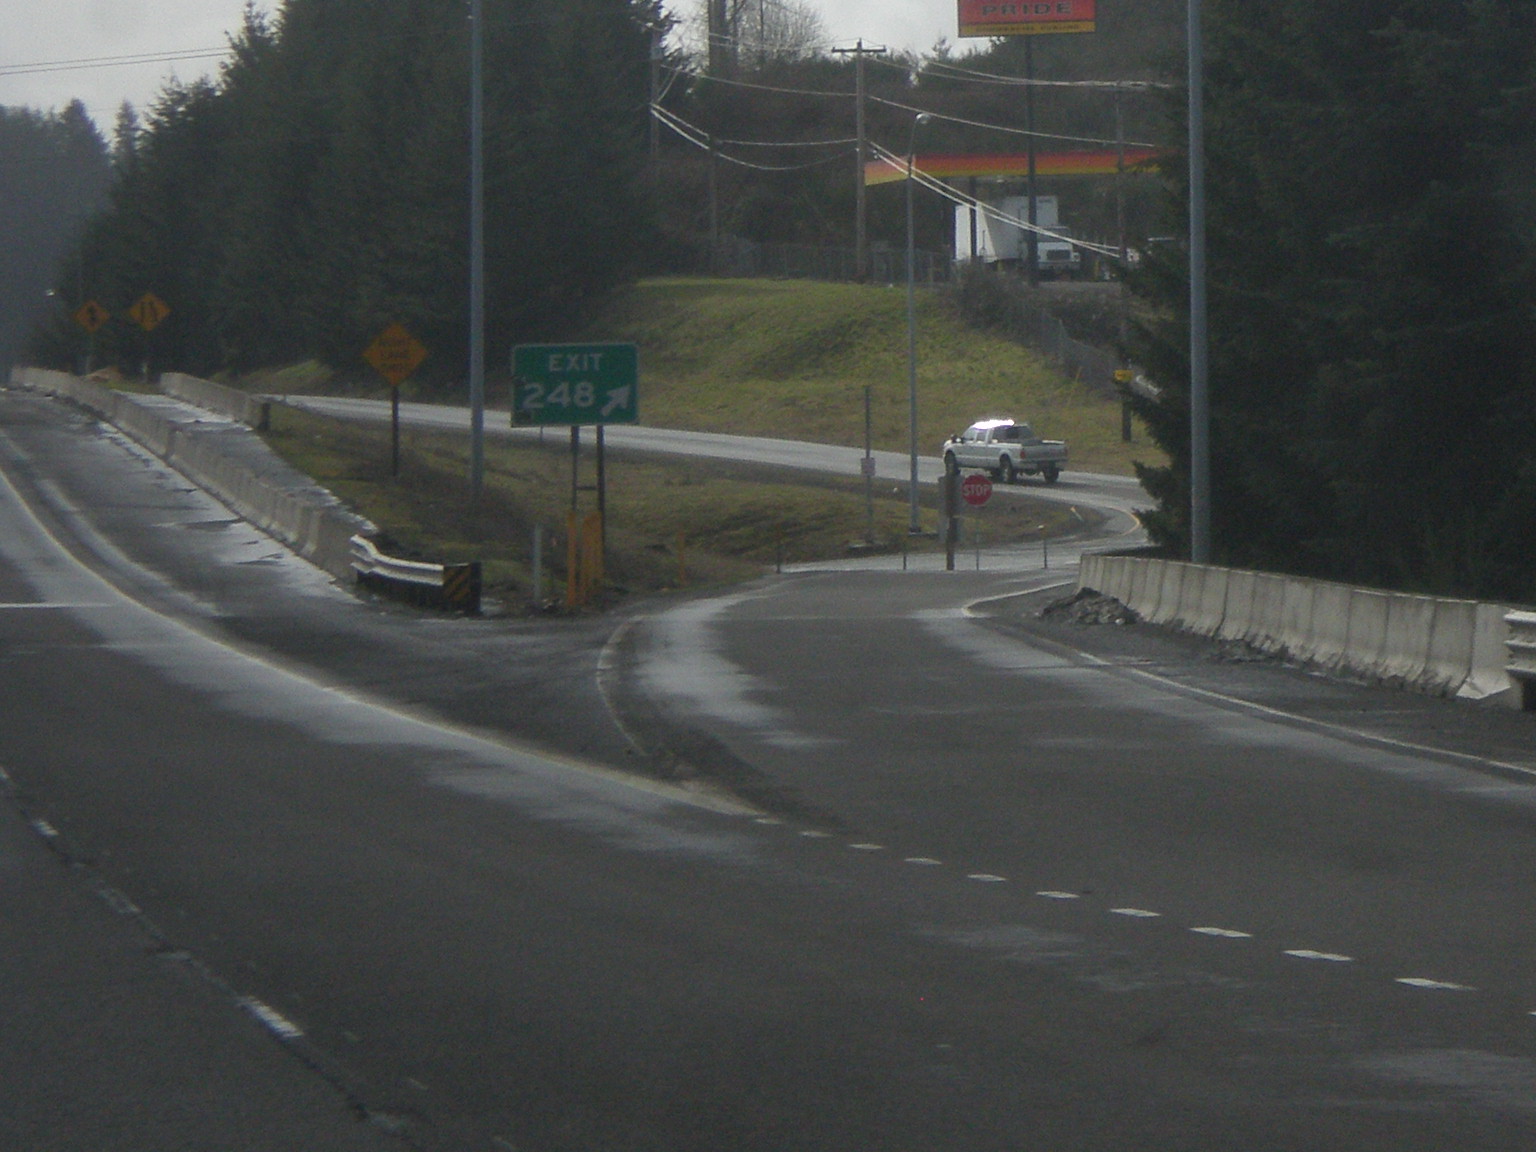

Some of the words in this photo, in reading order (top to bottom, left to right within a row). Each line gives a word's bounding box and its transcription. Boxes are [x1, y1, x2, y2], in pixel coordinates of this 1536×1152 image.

[982, 2, 1072, 16] PRIDE
[549, 353, 603, 372] EXIT
[521, 381, 597, 410] 248
[963, 484, 988, 496] STOP
